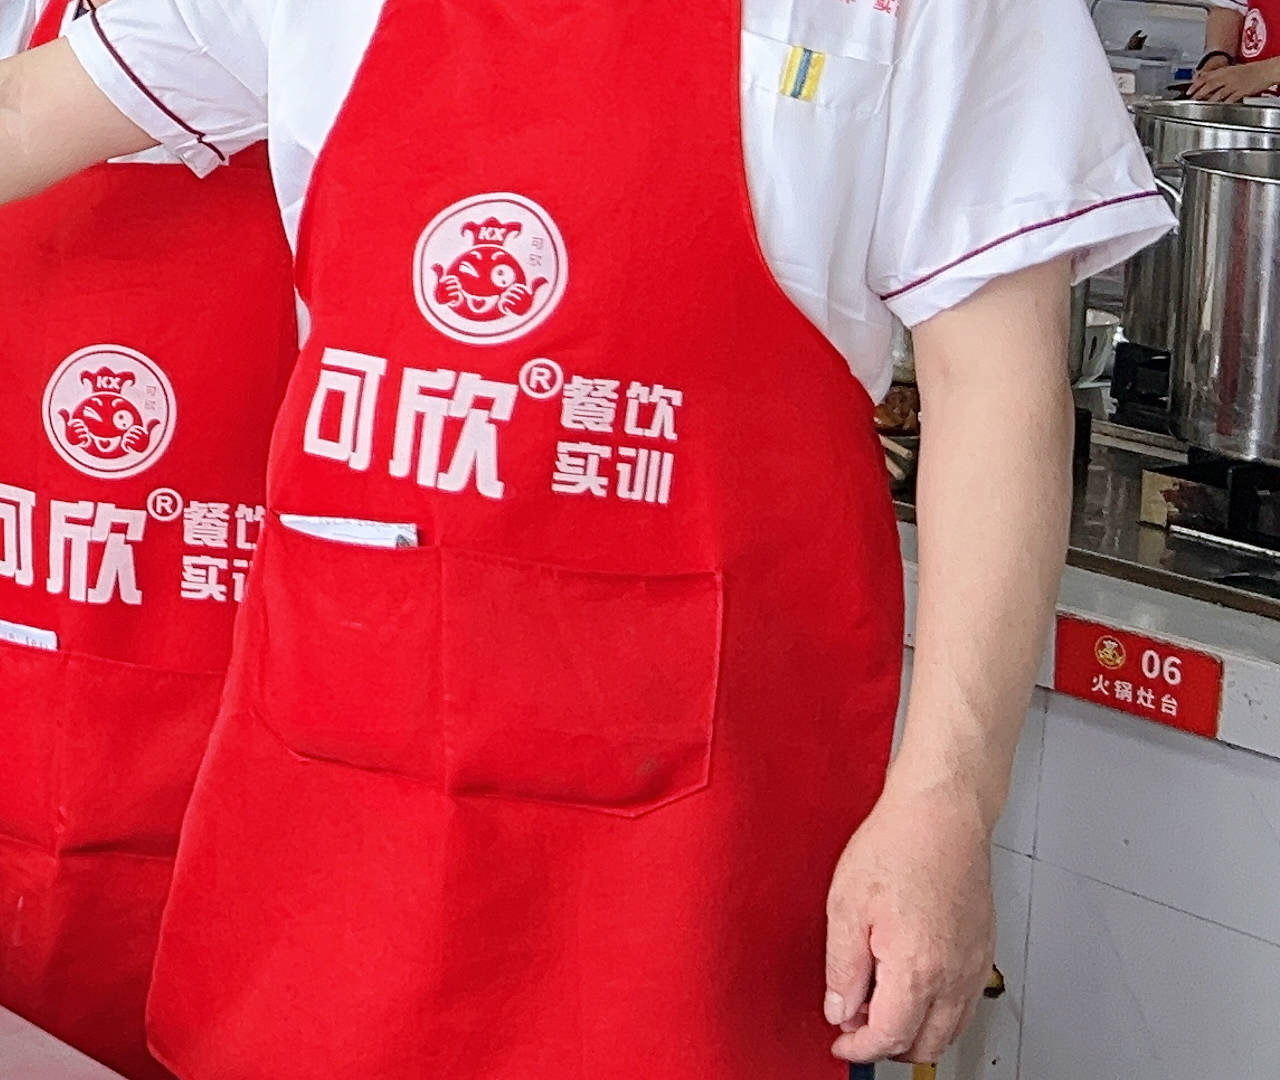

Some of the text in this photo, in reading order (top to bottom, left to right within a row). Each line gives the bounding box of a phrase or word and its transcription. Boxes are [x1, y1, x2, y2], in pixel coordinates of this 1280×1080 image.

[560, 374, 683, 441] 餐饮
[551, 440, 675, 504] 实训
[1141, 649, 1183, 686] 06
[1091, 673, 1178, 717] 火锅灶台
